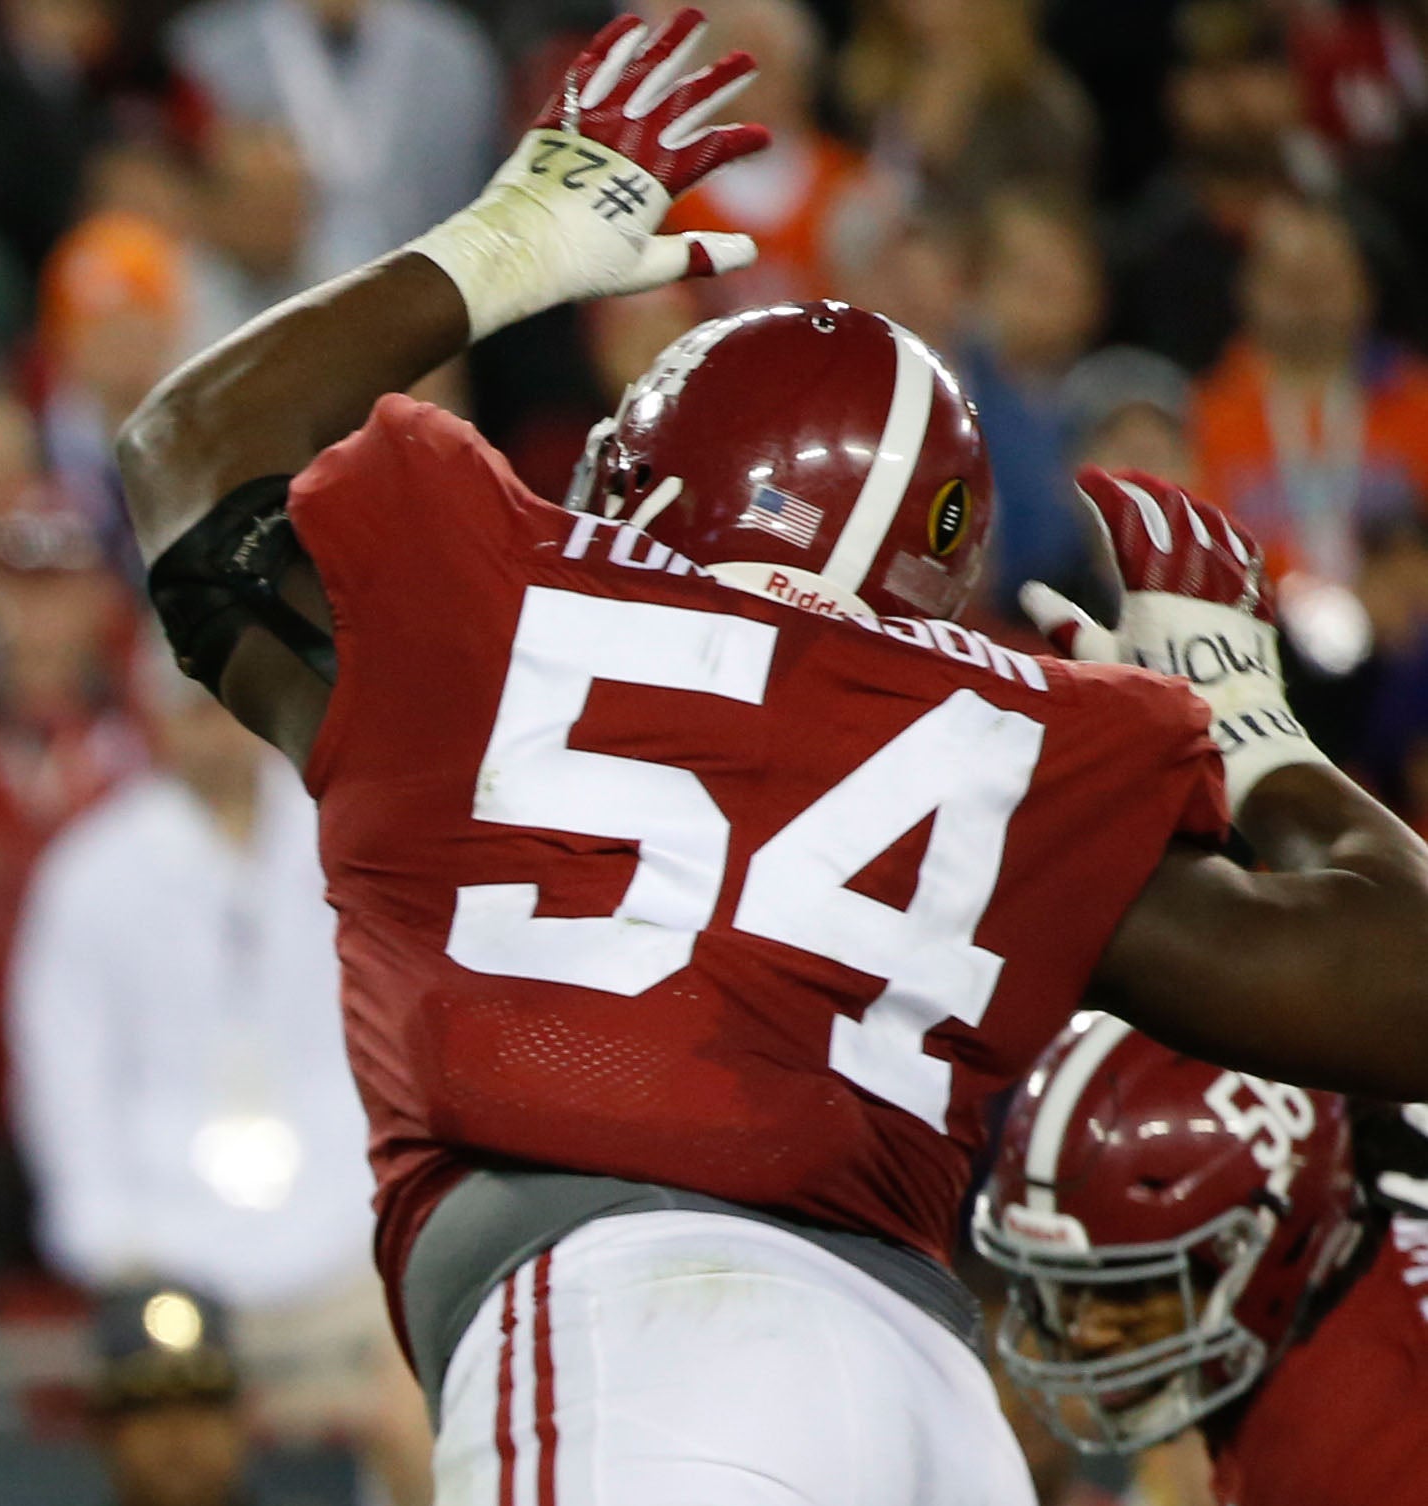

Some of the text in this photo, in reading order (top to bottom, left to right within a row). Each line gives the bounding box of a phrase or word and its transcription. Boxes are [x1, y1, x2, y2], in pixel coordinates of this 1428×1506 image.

[530, 138, 648, 221] #22
[446, 584, 1046, 1136] 54
[1203, 1071, 1316, 1171] 58
